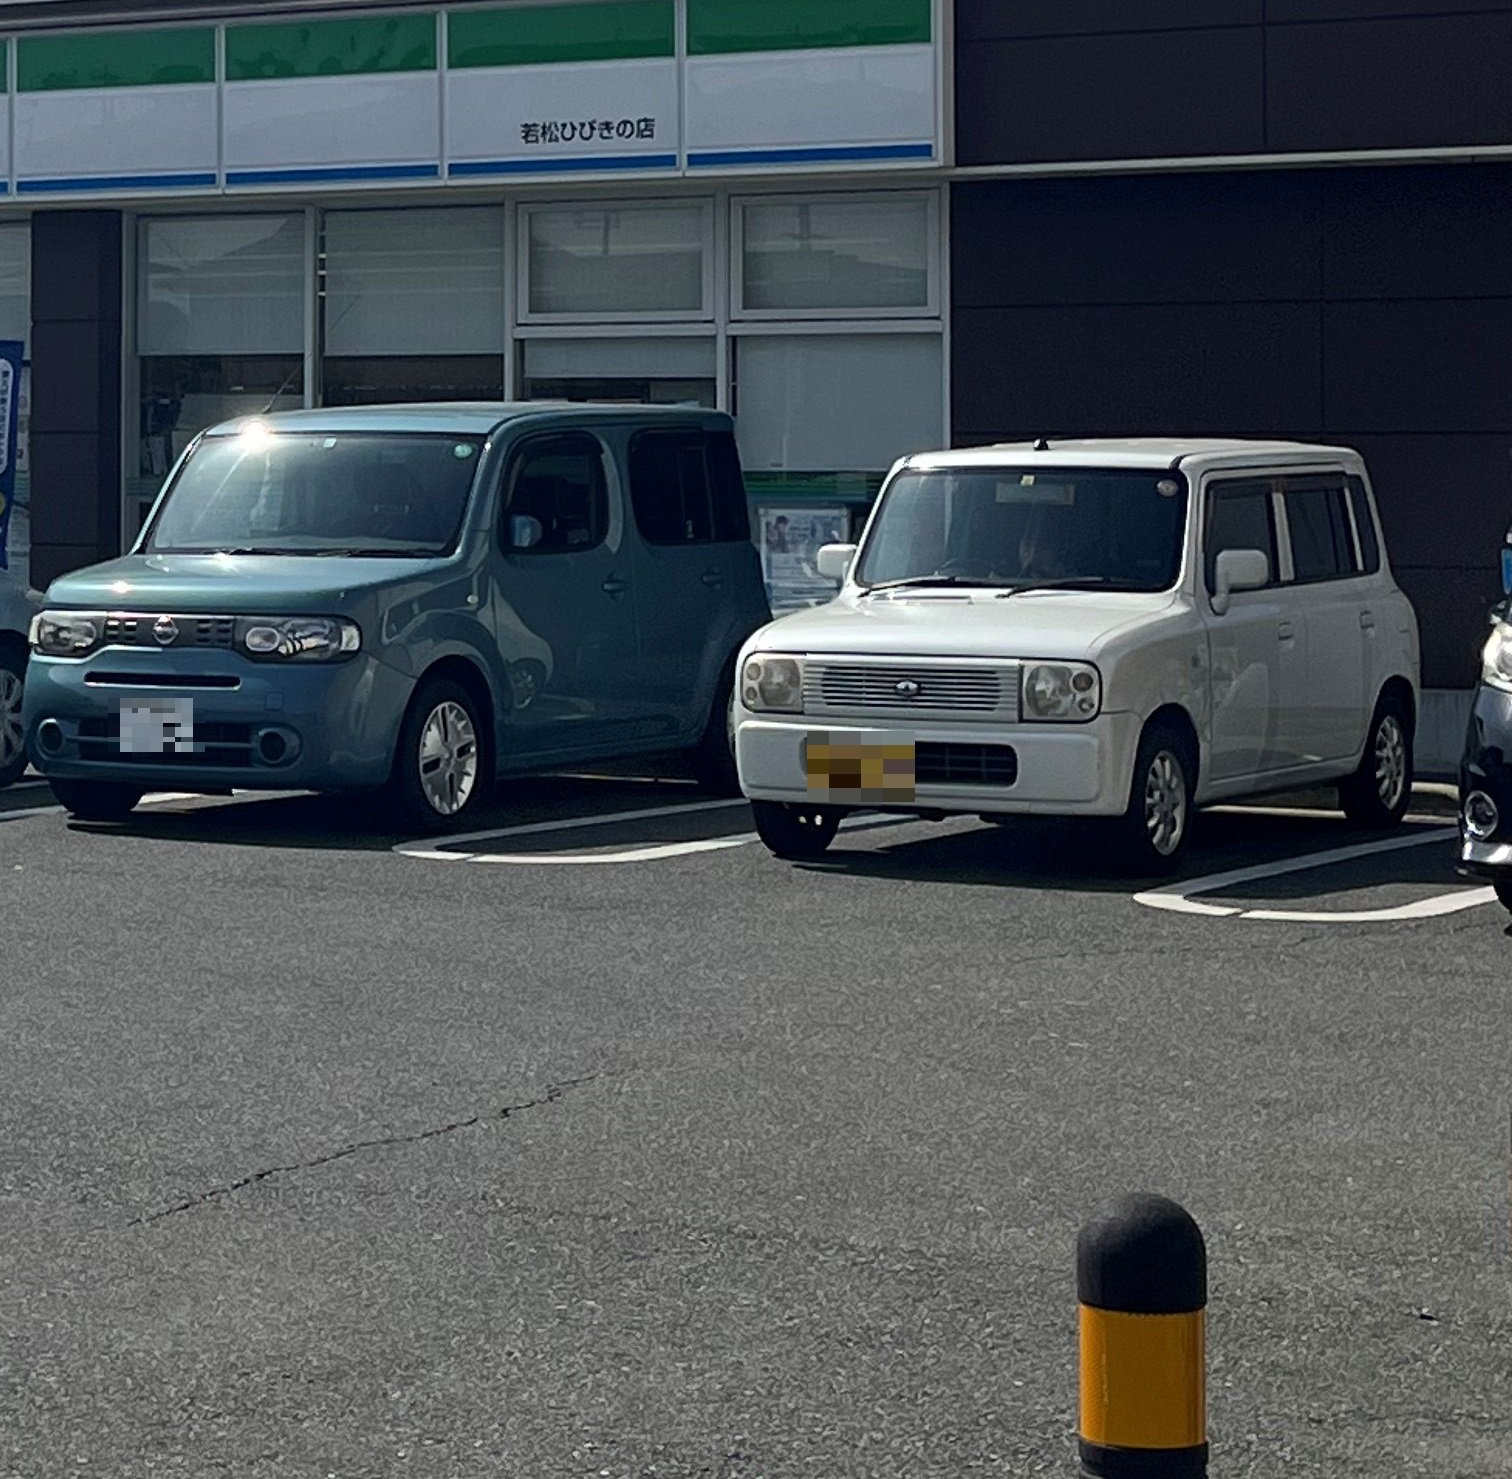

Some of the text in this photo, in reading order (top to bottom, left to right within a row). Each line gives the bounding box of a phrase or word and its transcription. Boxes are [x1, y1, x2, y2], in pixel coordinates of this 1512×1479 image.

[521, 117, 655, 144] 若松ひびきの店
